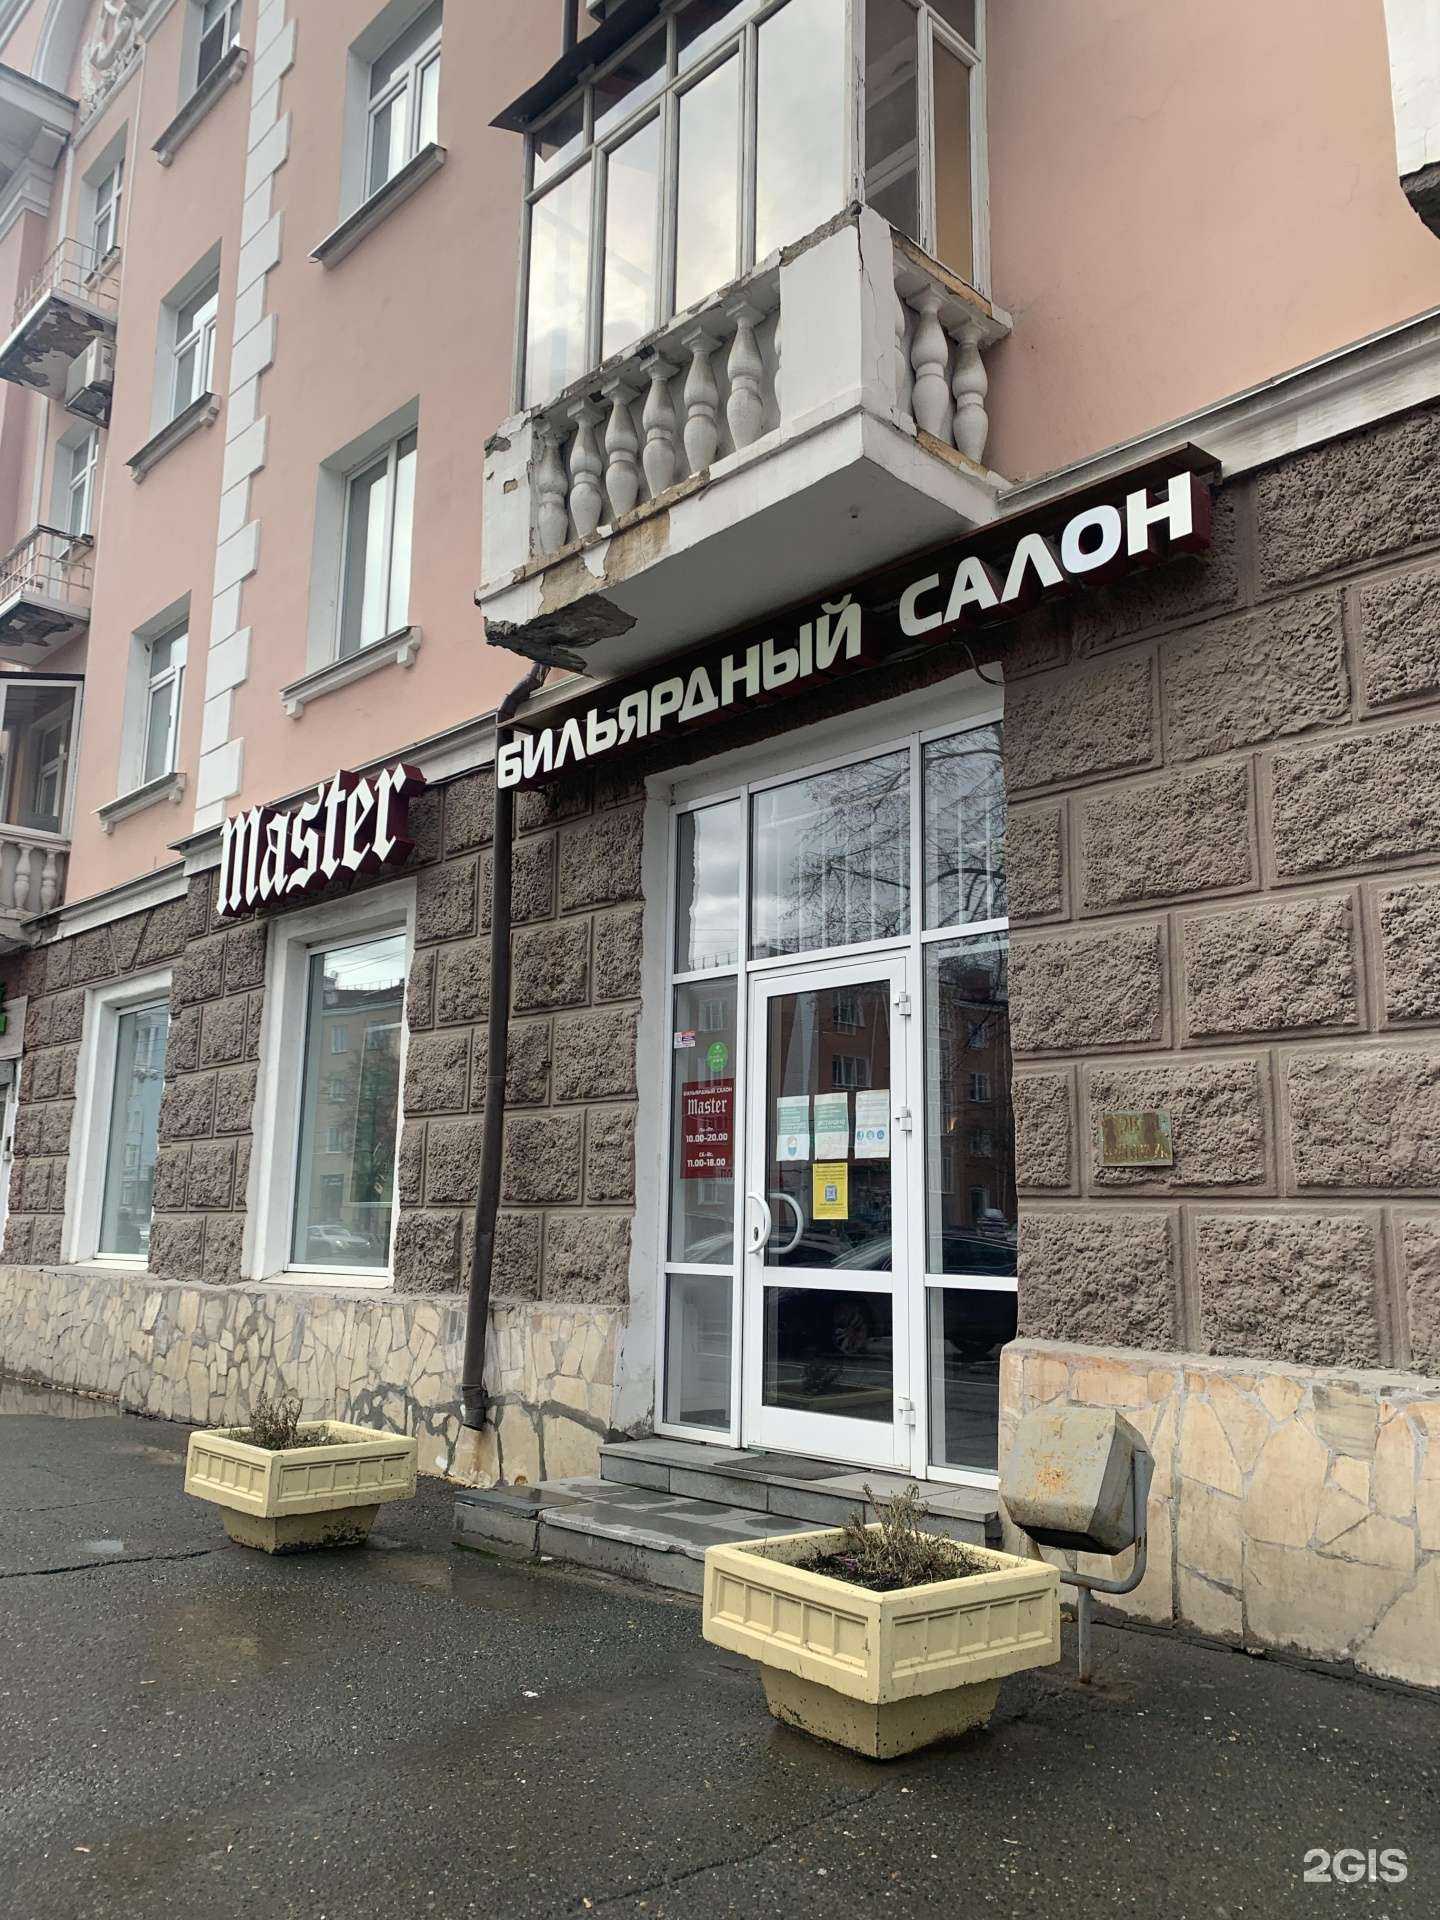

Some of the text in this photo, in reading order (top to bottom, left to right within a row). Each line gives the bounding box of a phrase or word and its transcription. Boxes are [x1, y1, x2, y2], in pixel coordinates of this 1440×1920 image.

[497, 471, 1193, 789] БИЛЬЯРДНЫЙ САЛОН
[216, 762, 407, 916] Master
[687, 1097, 728, 1115] Master
[685, 1132, 728, 1143] 10.00-20.00
[687, 1158, 726, 1168] 11.00-18.00
